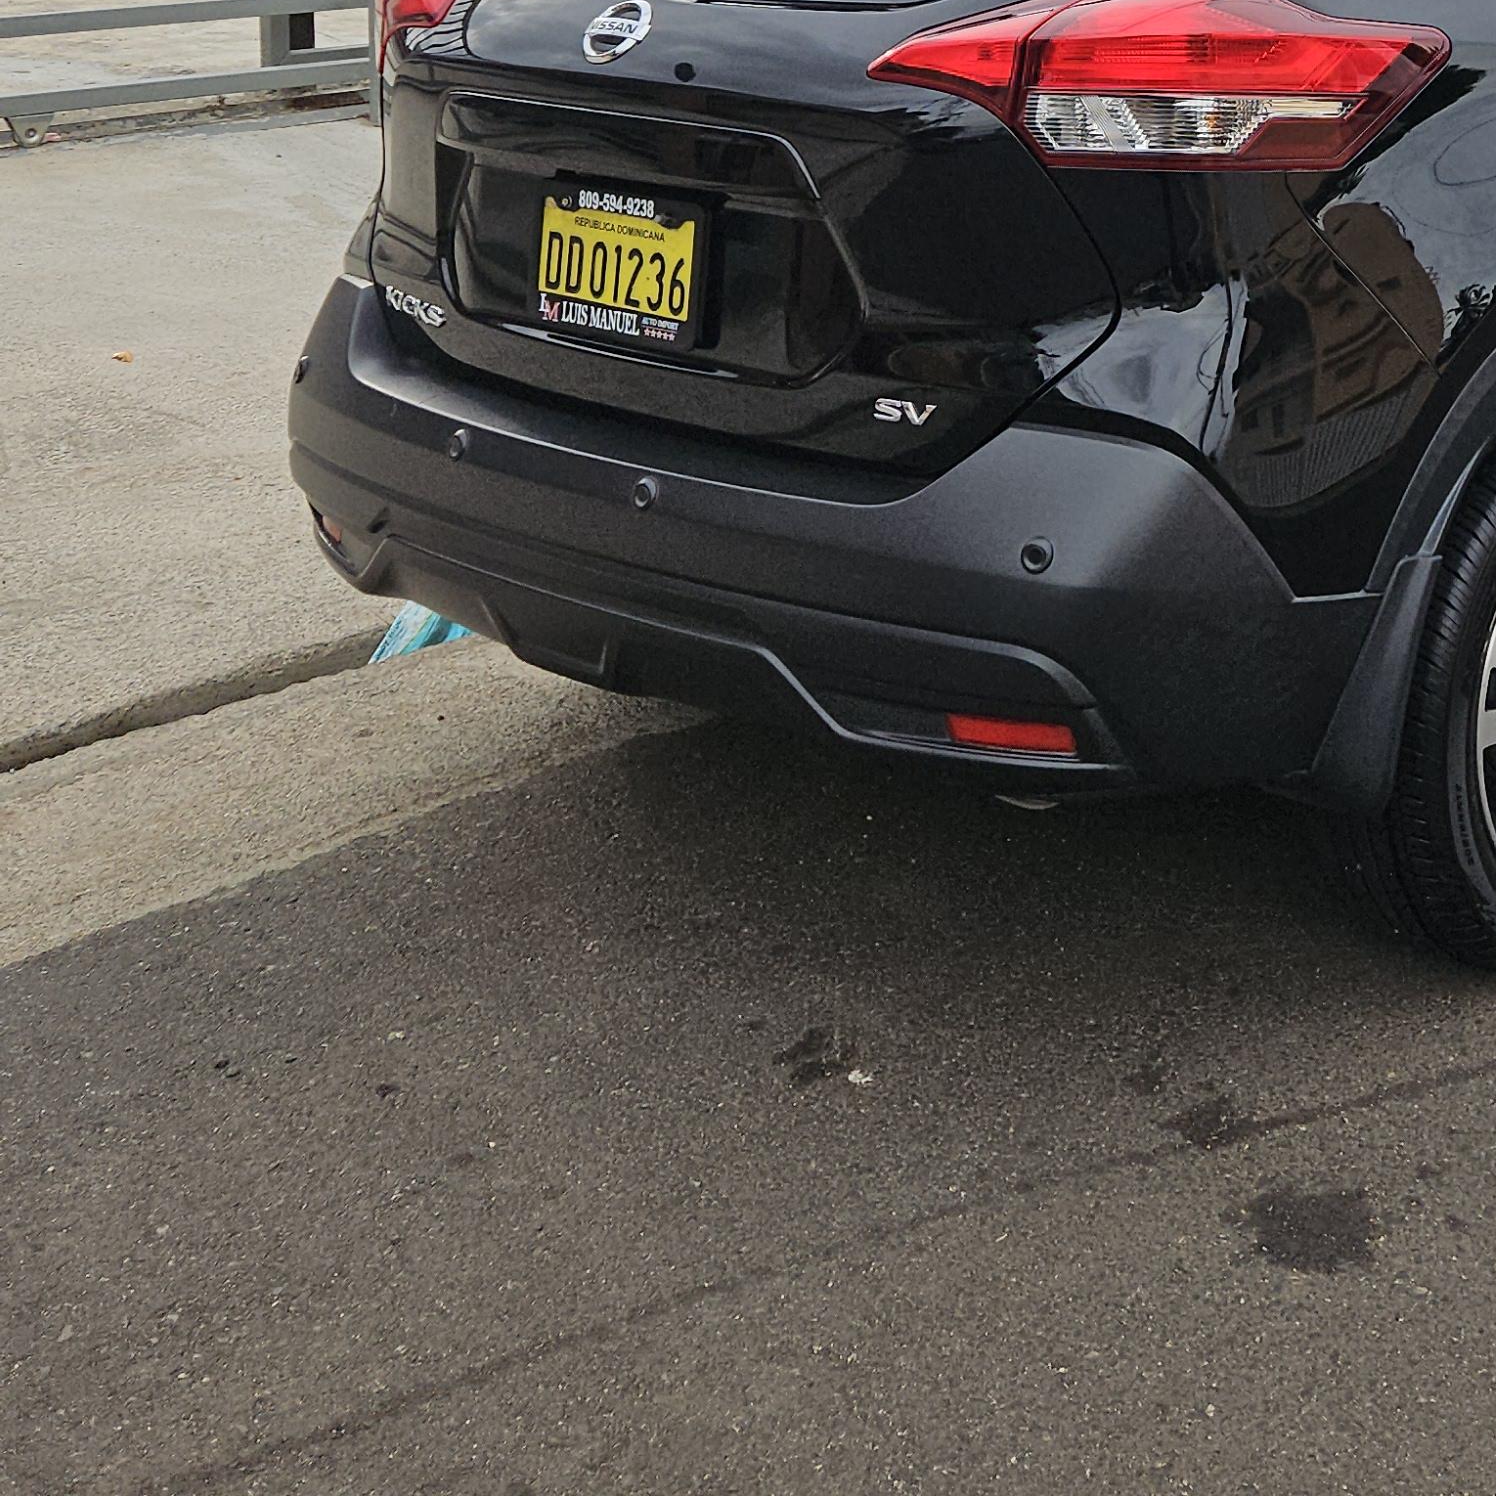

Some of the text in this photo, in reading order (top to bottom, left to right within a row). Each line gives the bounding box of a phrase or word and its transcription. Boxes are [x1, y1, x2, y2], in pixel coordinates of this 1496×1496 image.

[578, 189, 655, 219] 809-594-9238
[574, 216, 666, 243] REPUBLICA DOMINICANA
[544, 230, 686, 317] DD01236
[560, 300, 641, 337] LUIS MANUEL
[873, 397, 938, 426] SV
